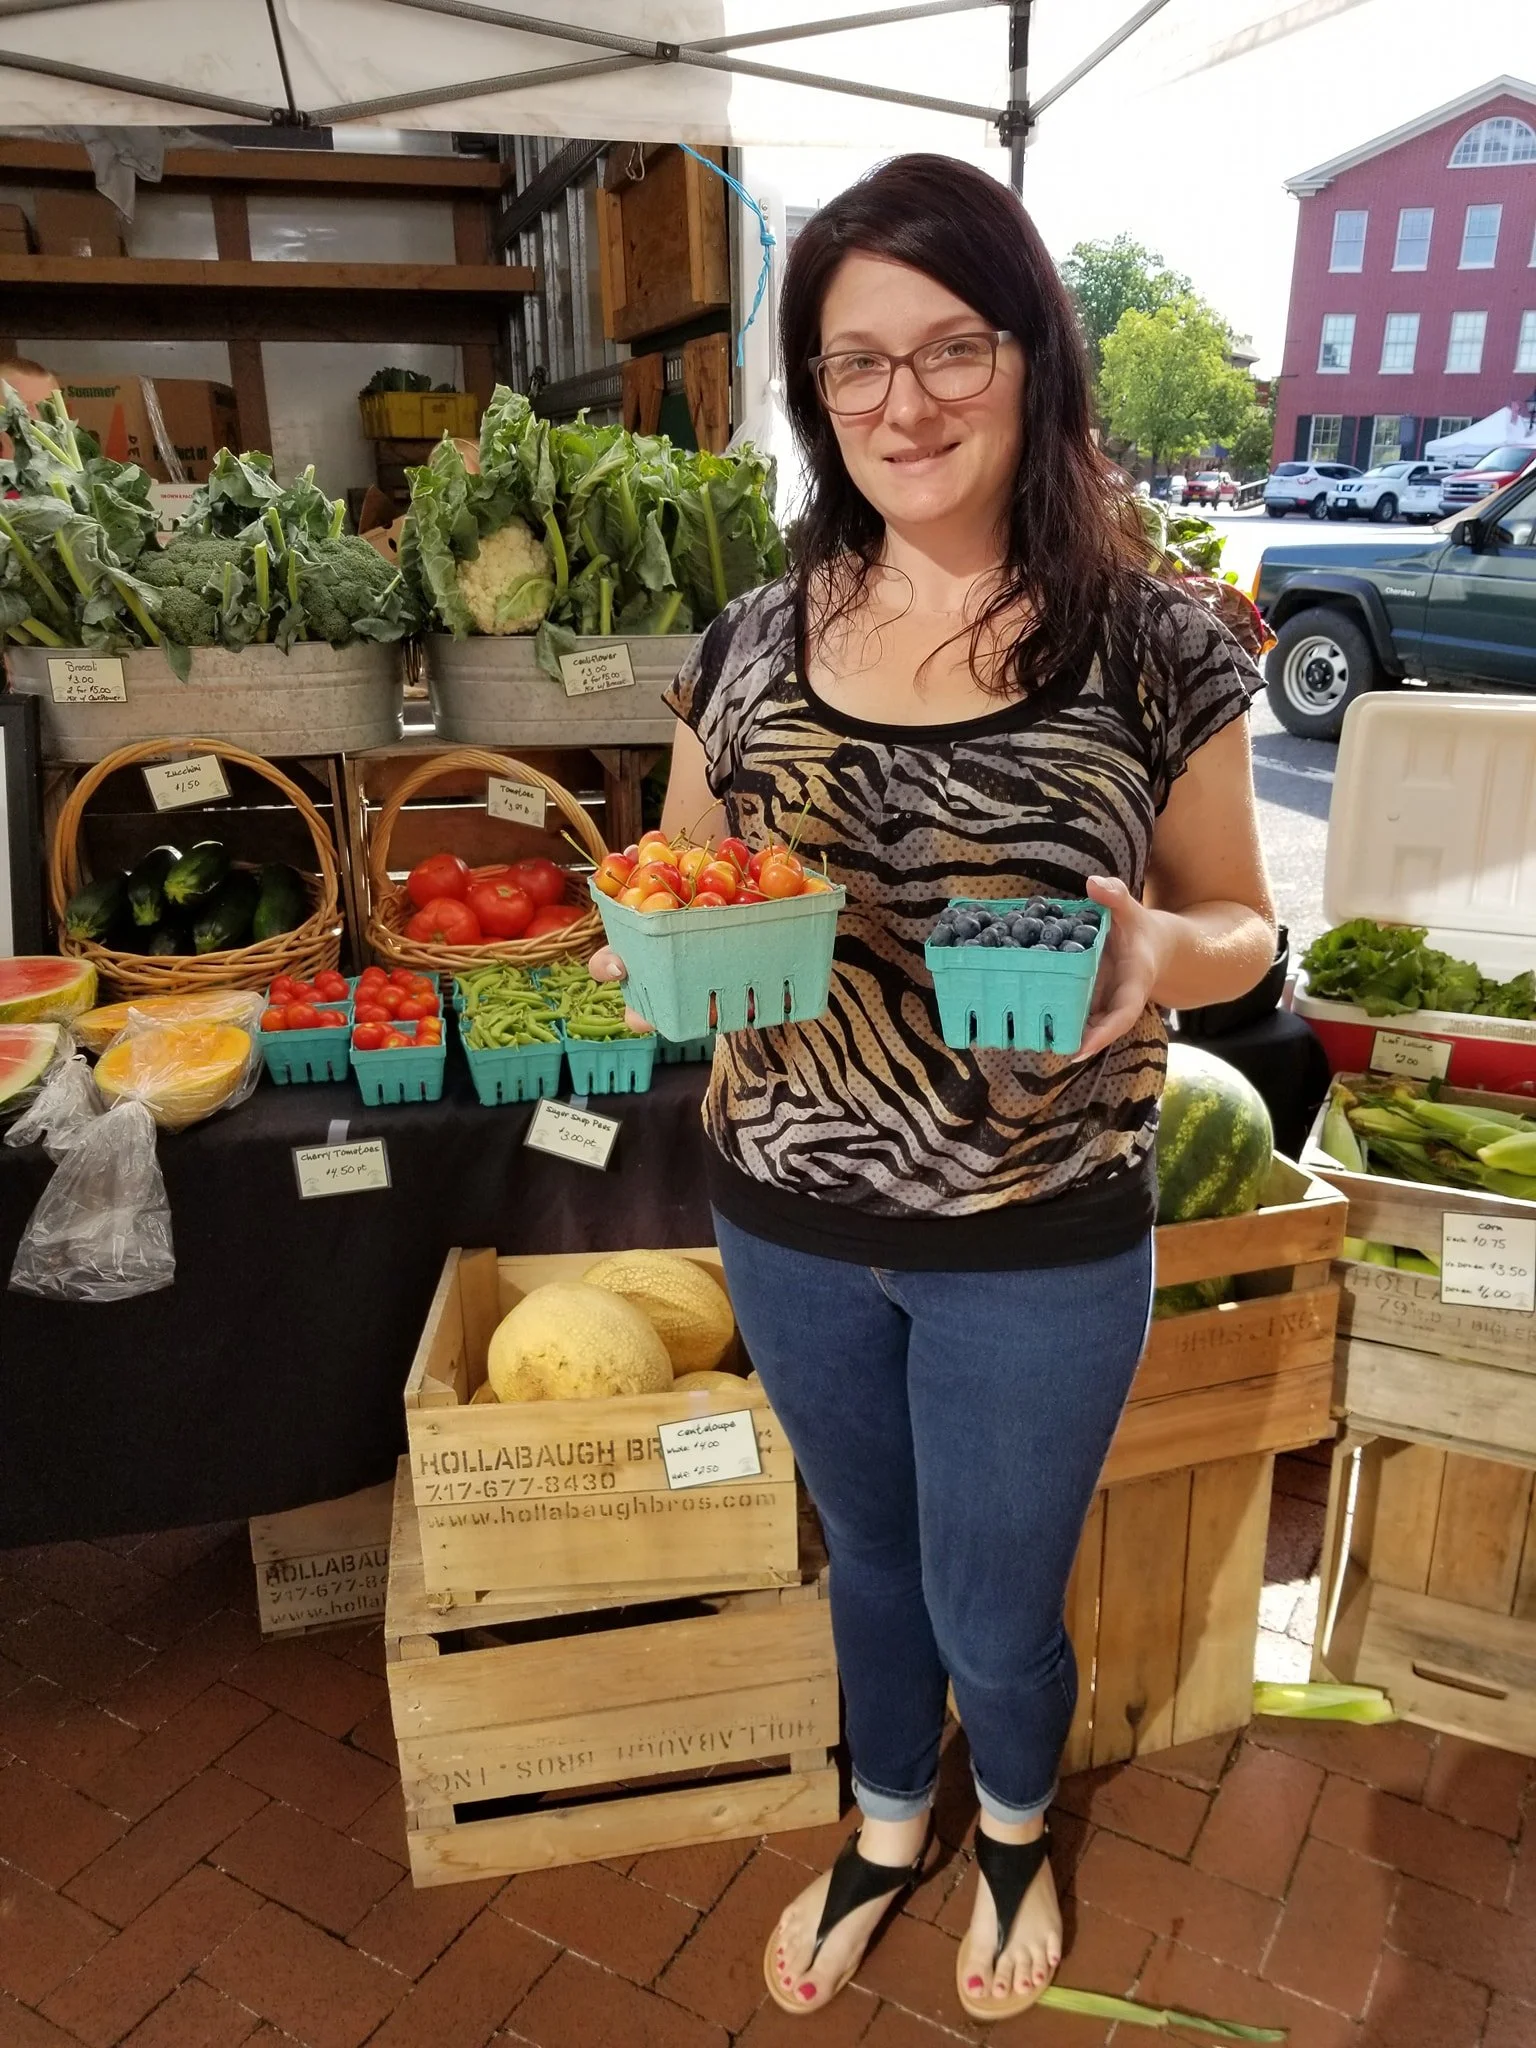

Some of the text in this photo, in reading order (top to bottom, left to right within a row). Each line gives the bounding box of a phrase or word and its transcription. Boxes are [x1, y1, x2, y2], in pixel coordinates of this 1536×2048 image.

[1385, 586, 1416, 597] Cherokee
[591, 676, 601, 684] for
[77, 686, 86, 694] for
[90, 685, 111, 694] $5.00
[165, 764, 201, 778] Zucchini
[175, 780, 200, 792] $1.50
[500, 785, 534, 798] Tomatoes
[546, 1106, 611, 1131] Sugar Snap Peas
[583, 1139, 597, 1148] pt
[333, 1146, 380, 1157] Tomatoes
[326, 1164, 367, 1178] $4.50 pt
[419, 1439, 616, 1476] HOLLABAUGH
[425, 1472, 616, 1502] 717-677-8430
[428, 1492, 776, 1528] www.hollabaughbros.com
